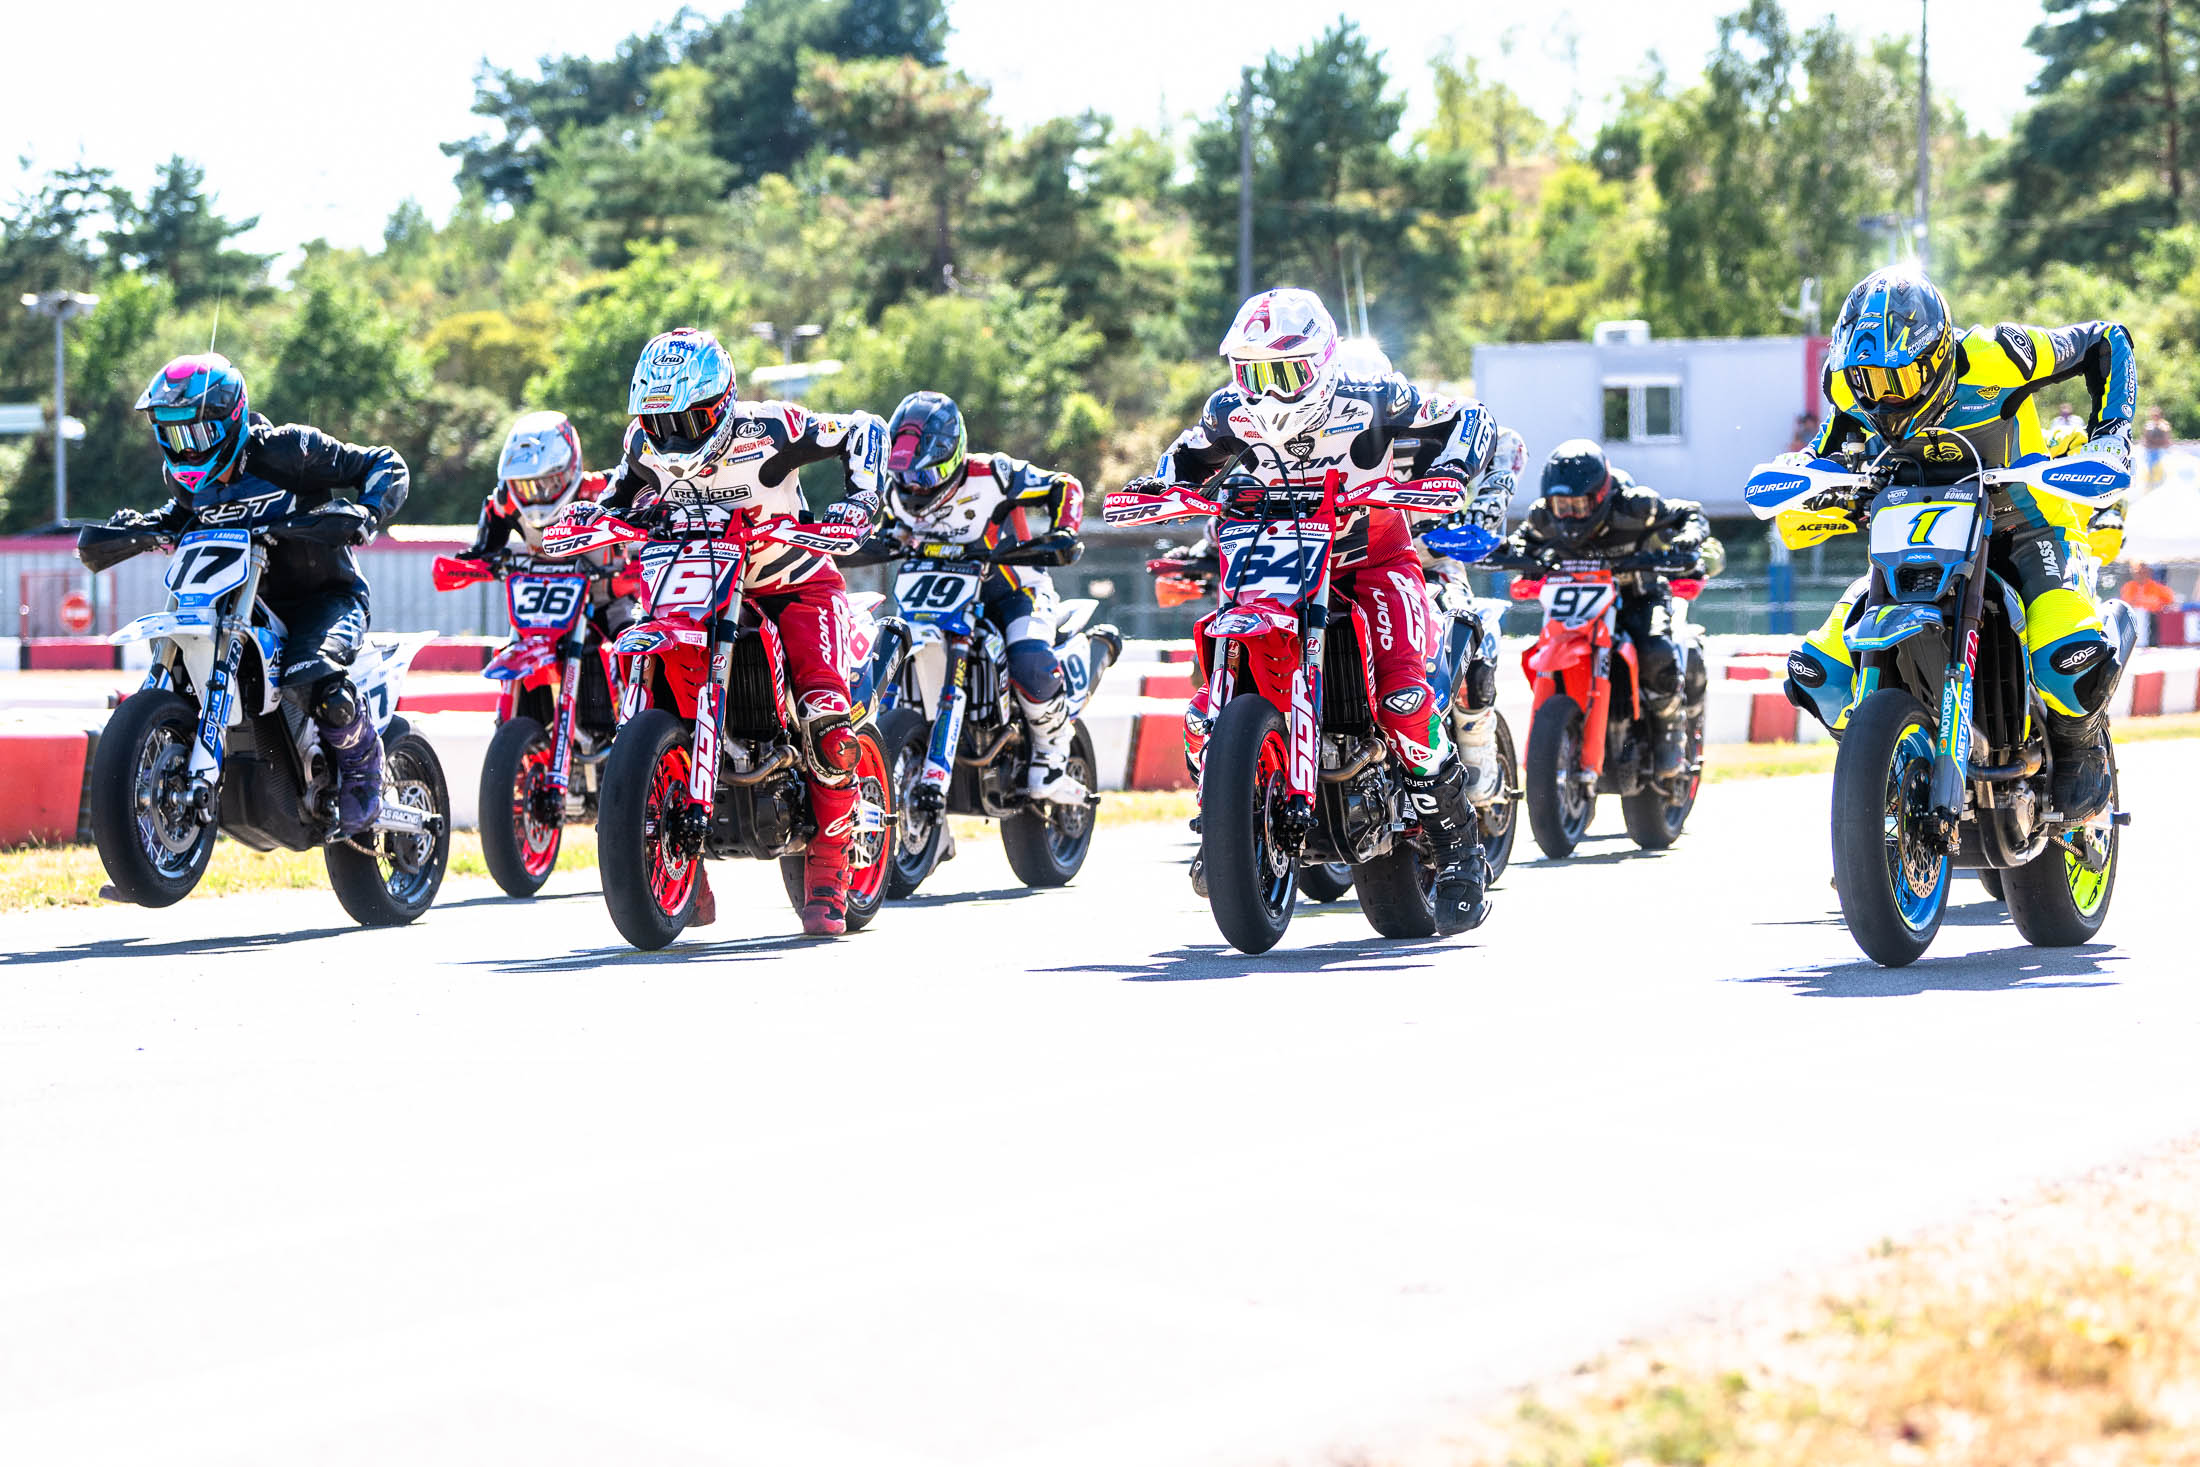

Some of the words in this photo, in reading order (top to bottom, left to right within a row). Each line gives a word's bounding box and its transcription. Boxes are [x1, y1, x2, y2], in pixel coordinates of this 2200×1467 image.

[653, 354, 684, 365] Arai
[1338, 384, 1384, 393] IXON
[737, 422, 766, 437] Arai
[1261, 453, 1347, 473] IXON
[1422, 481, 1461, 490] MOTUL
[1757, 480, 1804, 493] CIRCUIT
[2048, 474, 2097, 483] CIRCUIT
[198, 490, 287, 524] RST
[1104, 496, 1140, 505] MOTUL
[1388, 493, 1459, 506] SGR
[1104, 504, 1162, 522] SGR
[543, 527, 572, 536] MOTUL
[820, 526, 857, 535] MOTUL
[1298, 522, 1329, 530] MOTUL
[1908, 506, 1957, 546] 1
[545, 535, 593, 554] SGR
[711, 542, 740, 551] MOTUL
[789, 534, 853, 551] SGR
[170, 546, 245, 591] 17
[1225, 545, 1318, 589] 64
[2036, 540, 2063, 581] MASS
[655, 561, 722, 607] 6
[902, 575, 965, 609] 49
[517, 586, 575, 615] 36
[1551, 586, 1607, 618] 97
[1940, 687, 1953, 738] MOTOREX
[1290, 669, 1317, 792] SGR
[689, 686, 717, 803] SGR
[393, 810, 420, 824] RACING
